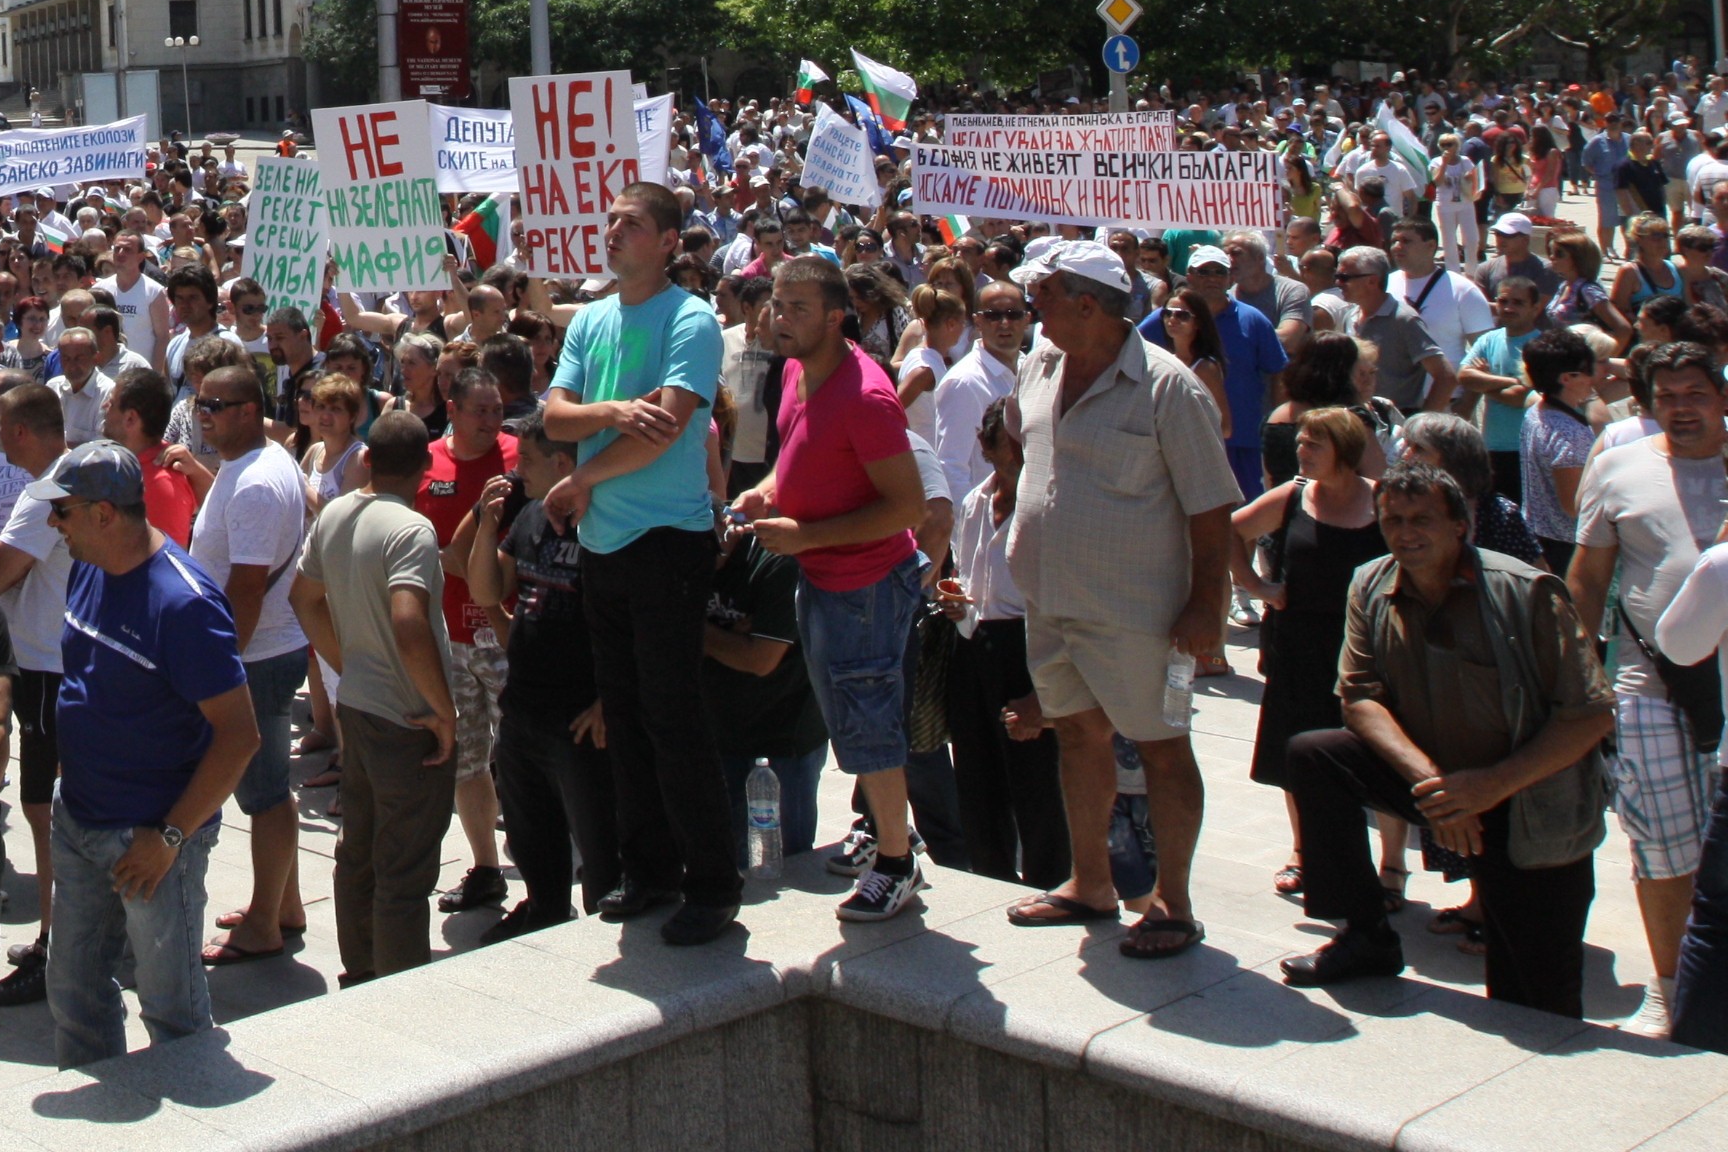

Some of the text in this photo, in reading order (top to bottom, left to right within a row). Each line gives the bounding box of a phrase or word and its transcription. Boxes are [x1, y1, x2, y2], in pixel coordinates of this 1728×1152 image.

[532, 77, 615, 161] НЕ!
[15, 134, 81, 156] ПЛАТЕНИТЕ
[83, 129, 136, 147] ЕКОЛОЗИ
[64, 151, 143, 176] ЗАВИНАГИ
[338, 111, 404, 180] НЕ
[438, 150, 487, 171] СКИТЕ
[917, 149, 1278, 183] В СОФИЯ НЕ ЖИВЕЯТ ВСИЧКИ БЪЛГАРИ!
[261, 195, 324, 226] РЕКЕТ
[350, 178, 442, 228] ЗЕЛЕНАТА
[523, 163, 569, 216] НА
[917, 173, 1282, 228] ИСКАМЕ ПОМИНЪК И НИЕ ОТ ПЛАНИНИТЕ
[255, 224, 319, 256] СРЕЩУ
[334, 235, 449, 288] МАФИЯ
[527, 225, 608, 275] РЕКЕ
[252, 252, 316, 295] ХЛЯБА
